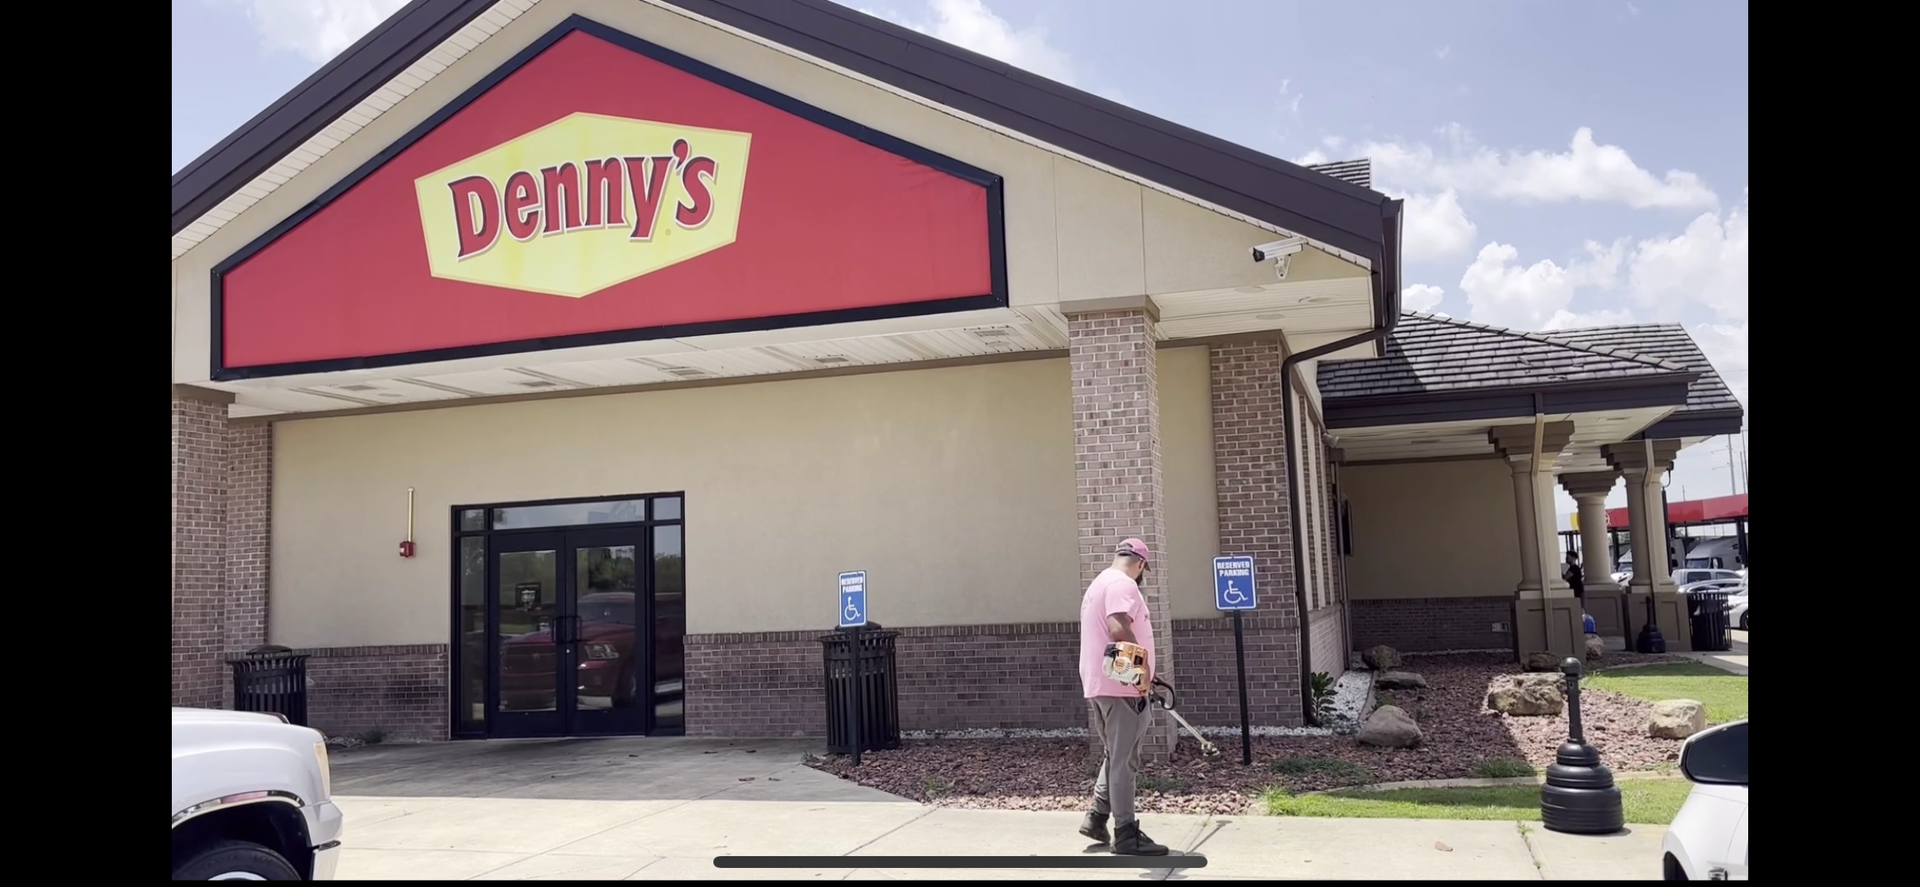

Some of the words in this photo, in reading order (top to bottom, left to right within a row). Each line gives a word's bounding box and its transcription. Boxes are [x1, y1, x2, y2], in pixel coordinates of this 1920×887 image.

[448, 138, 719, 263] Denny's
[1217, 561, 1251, 570] RESERVED
[1219, 569, 1250, 577] PARKING
